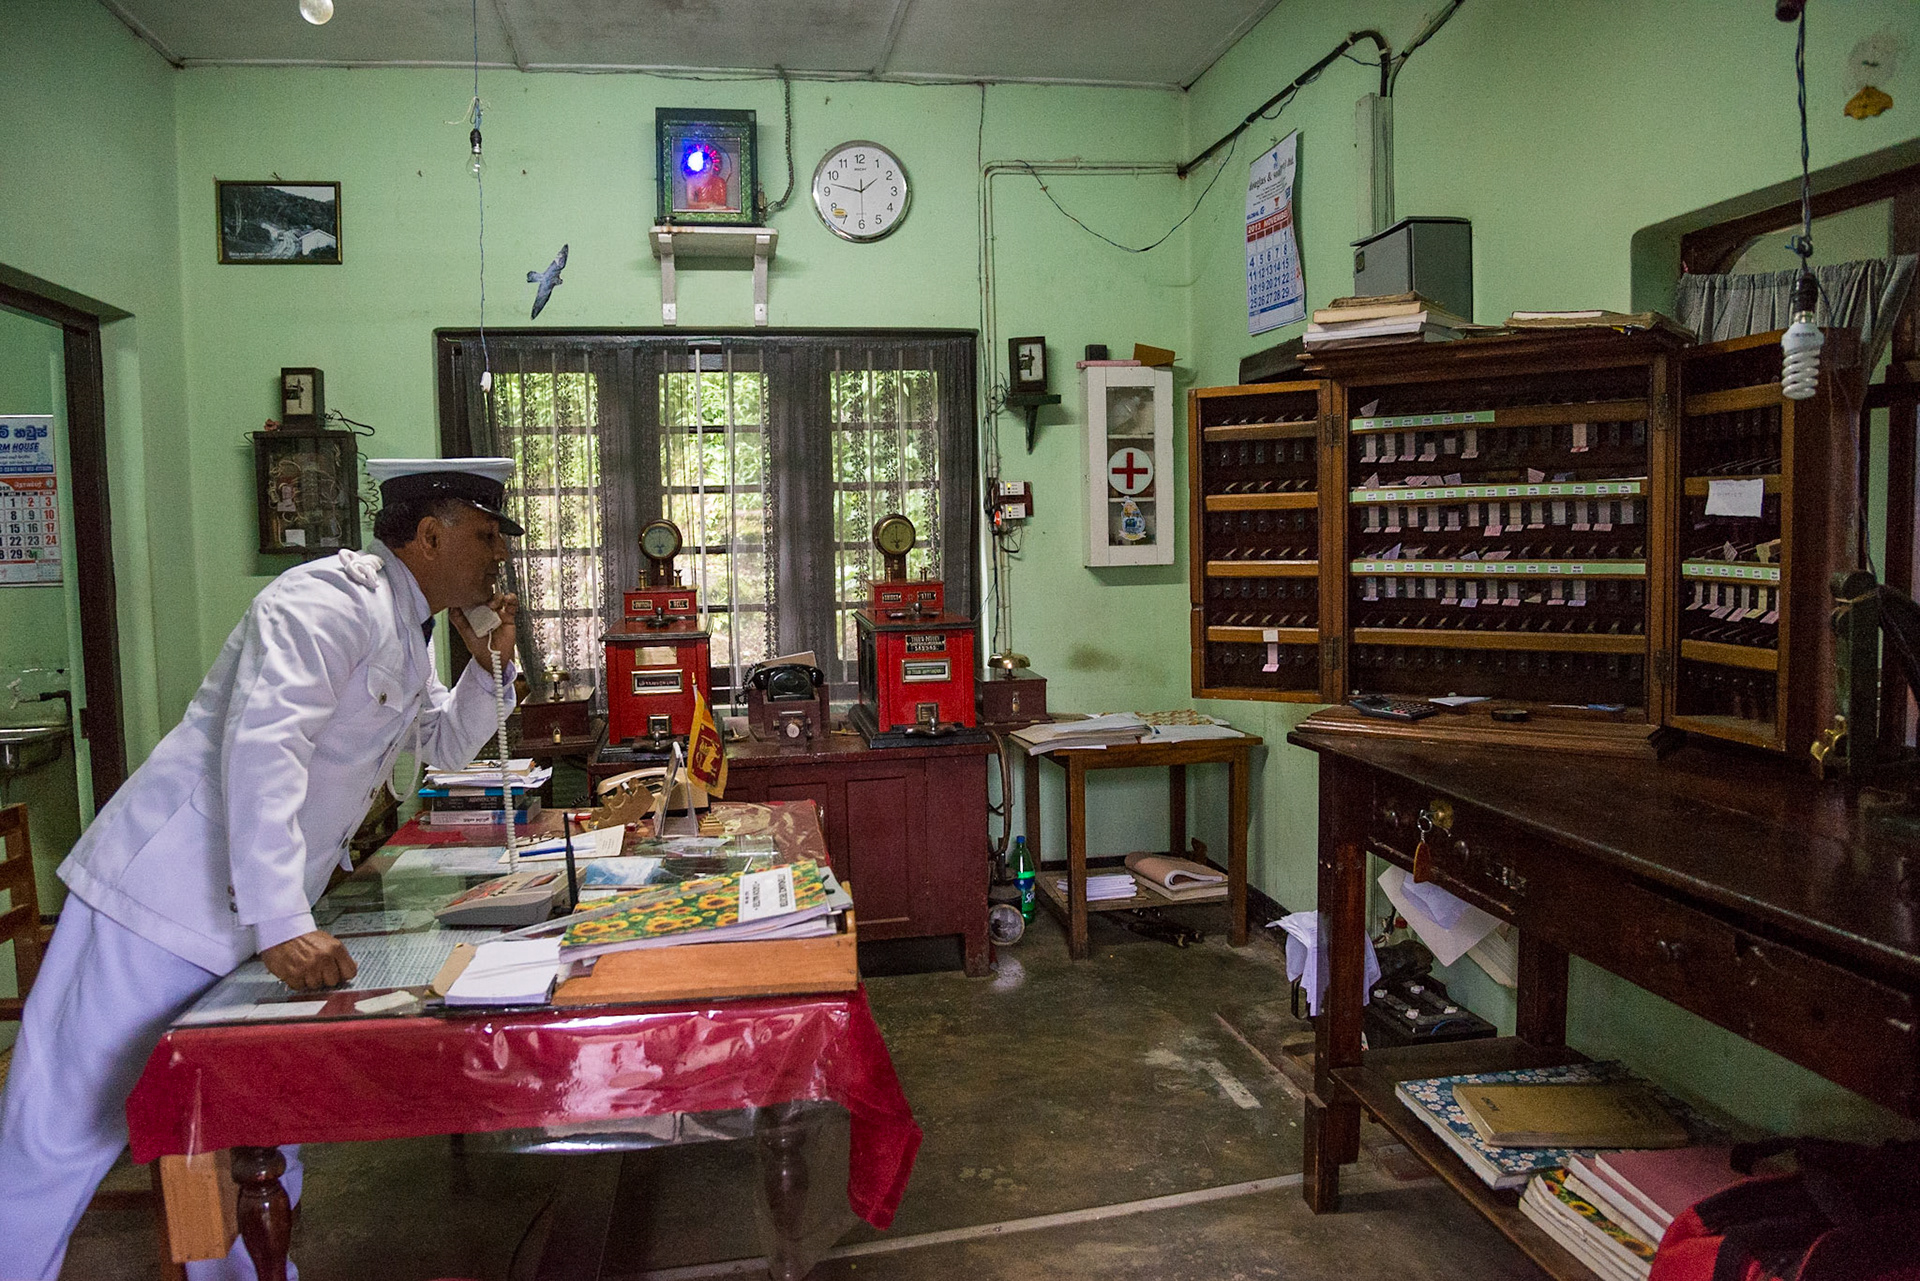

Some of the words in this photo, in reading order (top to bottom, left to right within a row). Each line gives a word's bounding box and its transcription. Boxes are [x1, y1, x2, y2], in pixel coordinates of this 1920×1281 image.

[839, 159, 848, 168] 11
[854, 154, 865, 164] 12
[875, 159, 880, 168] 1
[827, 170, 839, 180] 10
[886, 170, 893, 180] 2
[1267, 172, 1272, 182] &
[824, 186, 831, 197] 9
[890, 186, 898, 197] 3
[831, 202, 838, 212] 8
[887, 203, 894, 212] 4
[875, 214, 882, 224] 5
[858, 220, 866, 230] 6
[1248, 222, 1262, 234] 2013
[1250, 257, 1254, 267] 4
[1260, 254, 1264, 264] 5
[1268, 250, 1271, 262] 6
[1275, 248, 1279, 258] 7
[1284, 244, 1287, 255] 8
[1249, 270, 1256, 281] 11
[1258, 268, 1264, 278] 12
[1266, 264, 1272, 275] 13
[1274, 262, 1280, 272] 14
[1282, 258, 1288, 270] 15
[1250, 284, 1256, 296] 18
[1258, 282, 1264, 292] 19
[1266, 278, 1272, 290] 20
[1274, 276, 1280, 287] 21
[1282, 272, 1289, 284] 22
[1250, 298, 1256, 309] 25
[1258, 295, 1265, 306] 26
[1266, 292, 1272, 304] 27
[1274, 290, 1280, 301] 28
[1282, 286, 1289, 298] 29
[12, 442, 40, 452] HOUSE
[10, 498, 16, 507] 1
[28, 497, 34, 507] 2
[45, 496, 52, 506] 3
[10, 510, 17, 520] 8
[28, 510, 35, 520] 9
[44, 510, 54, 520] 10
[9, 524, 20, 534] 15
[27, 523, 38, 533] 16
[45, 522, 54, 532] 17
[10, 536, 22, 546] 22
[28, 536, 40, 546] 23
[46, 535, 56, 545] 24
[10, 550, 22, 560] 29
